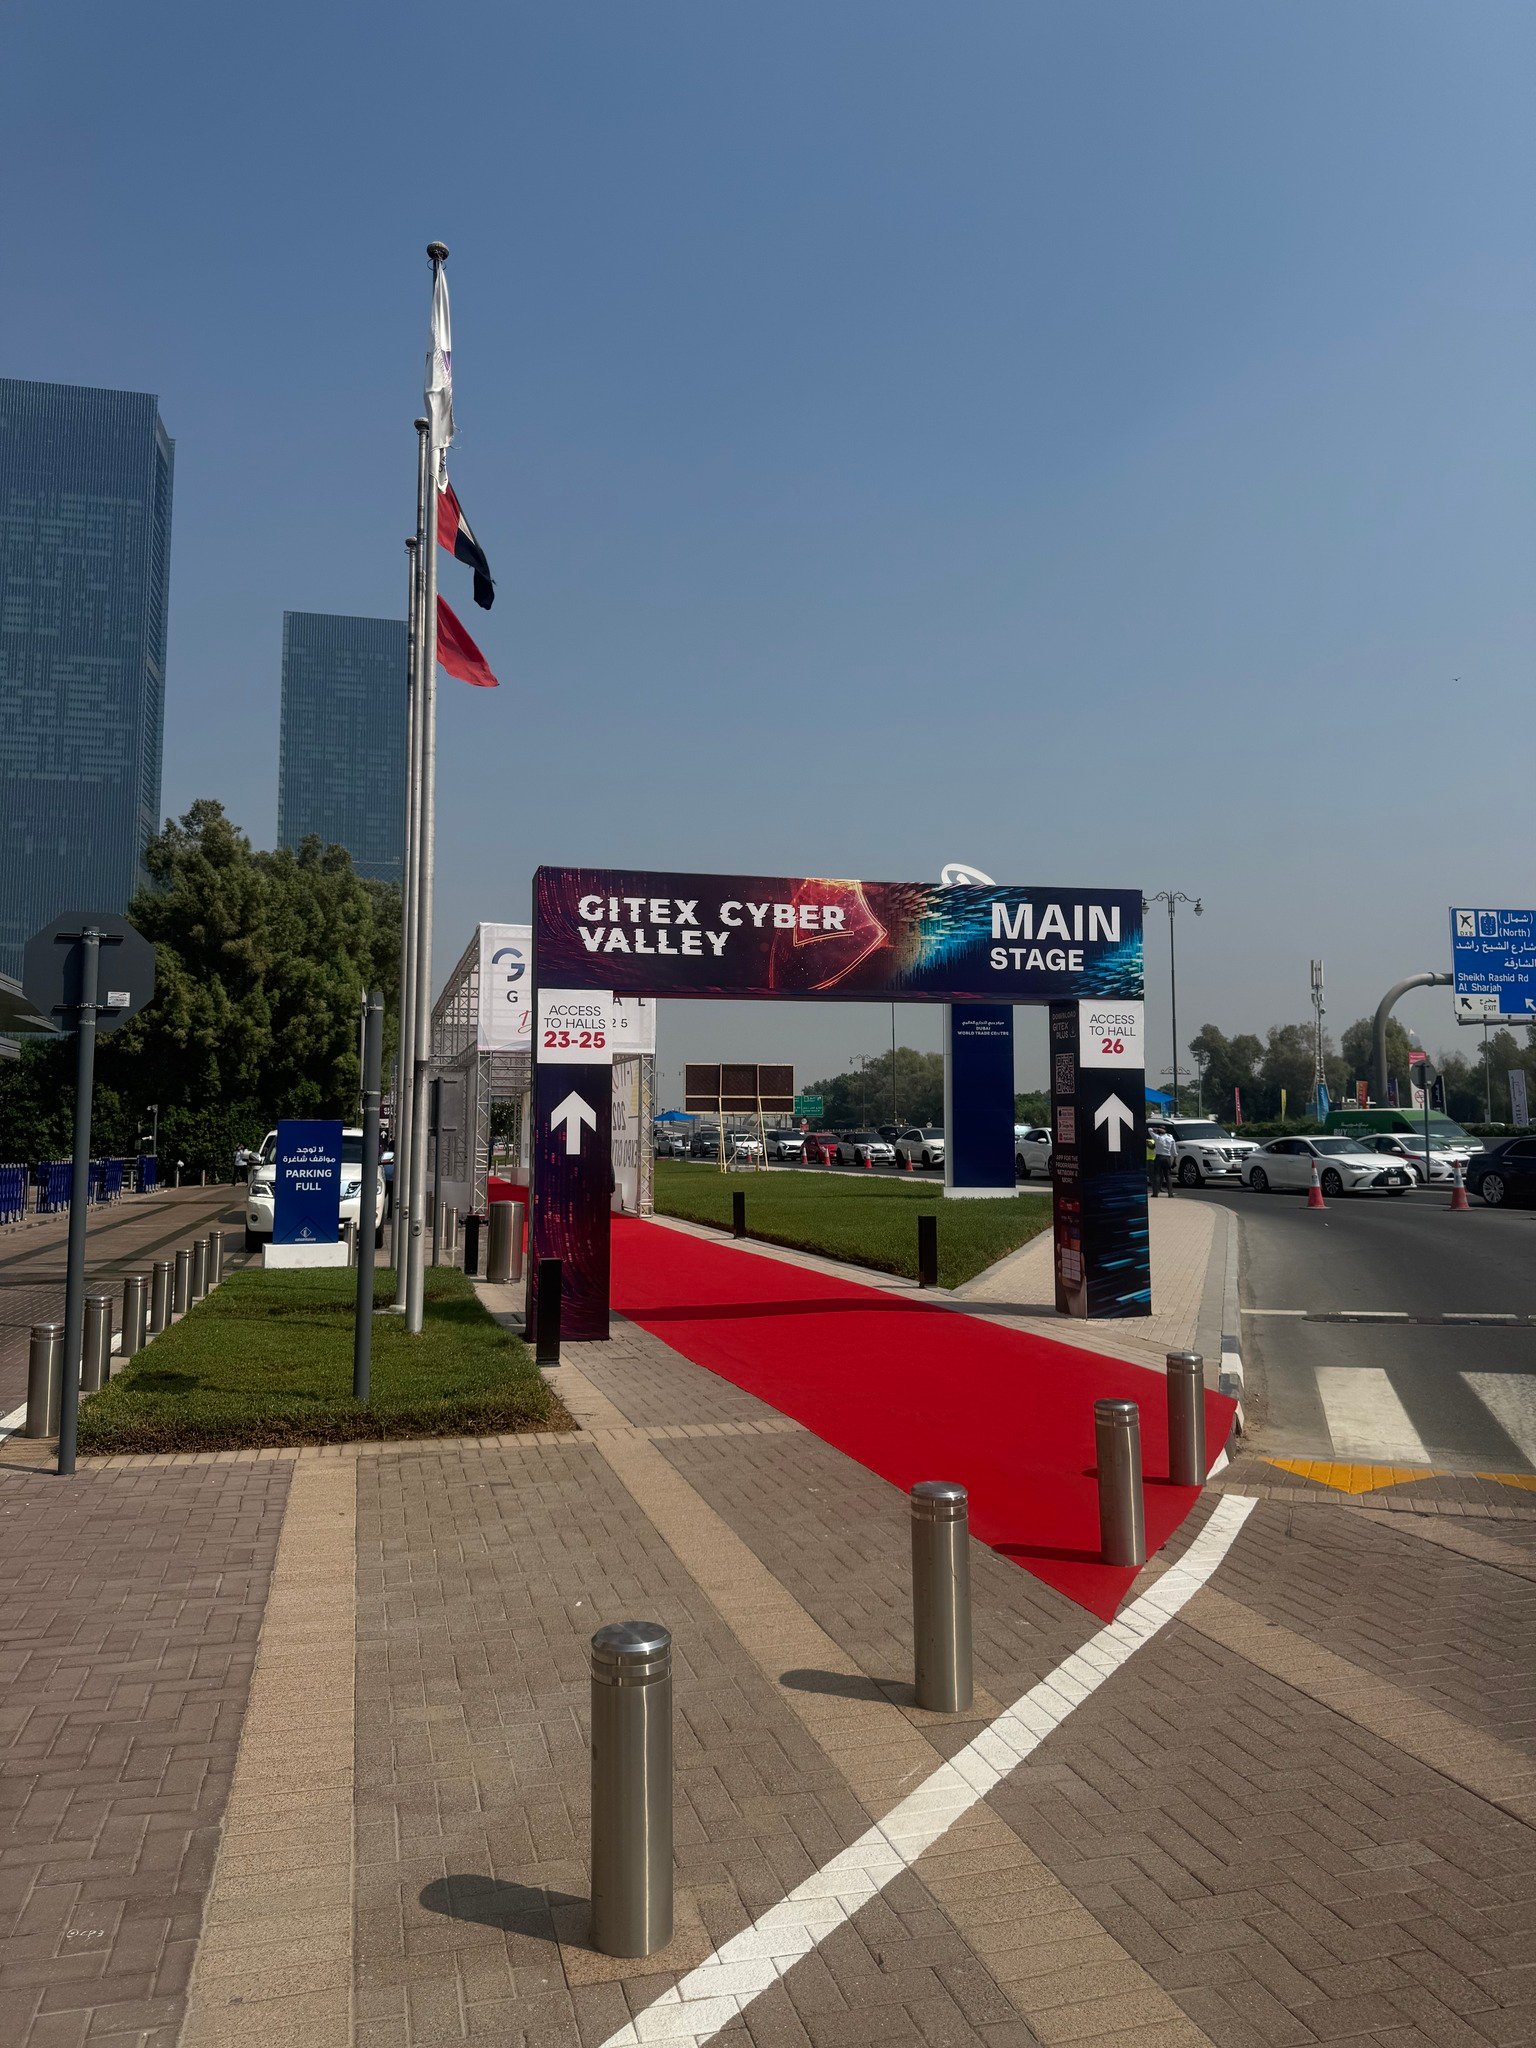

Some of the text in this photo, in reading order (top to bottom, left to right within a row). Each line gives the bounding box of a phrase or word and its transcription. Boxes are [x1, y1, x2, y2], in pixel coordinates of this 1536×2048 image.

[577, 893, 847, 930] GITEX CYBER
[991, 902, 1121, 943] MAIN
[1499, 928, 1531, 938] (North)
[577, 926, 730, 956] VALLEY
[1455, 940, 1480, 952] راشد
[1482, 940, 1509, 953] الشيخ
[990, 946, 1085, 972] STAGE
[1457, 972, 1529, 982] Sheikh Rashid Rd
[1458, 982, 1502, 993] Al Sharjah
[548, 1004, 602, 1017] ACCESS
[543, 1017, 562, 1029] TO
[565, 1018, 606, 1030] HALLS
[1089, 1013, 1135, 1025] ACCESS
[1089, 1025, 1137, 1037] TO HALL
[543, 1030, 606, 1049] 23-25
[1101, 1037, 1125, 1054] 26
[295, 1145, 324, 1154] لا توجد
[282, 1154, 336, 1164] مواقف شاغرة
[285, 1169, 332, 1178] PARKING
[295, 1182, 322, 1191] FULL
